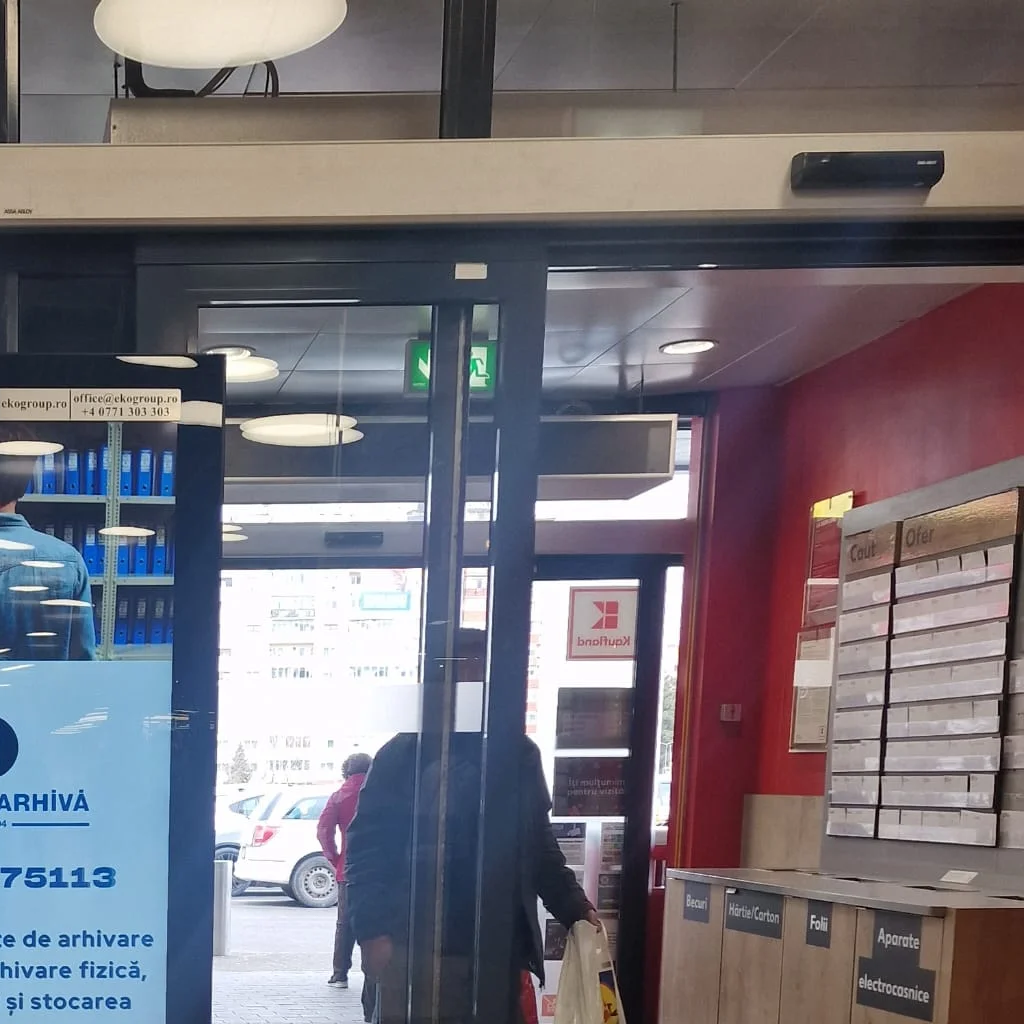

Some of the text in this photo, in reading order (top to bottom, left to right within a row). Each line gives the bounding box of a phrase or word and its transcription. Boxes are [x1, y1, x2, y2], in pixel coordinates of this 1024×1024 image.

[1, 399, 67, 411] ekogroup.ro
[73, 393, 178, 406] office@ekogroup.ro
[82, 407, 170, 417] +4 0771 303 303
[905, 527, 935, 548] Ofer
[686, 894, 708, 911] Becuri
[810, 914, 828, 932] Folii
[23, 930, 51, 948] de
[58, 930, 154, 948] arhivare
[877, 927, 920, 950] Aparate
[79, 961, 147, 982] fizică,
[858, 974, 930, 1004] electrocasnice
[6, 992, 24, 1016] și
[31, 993, 132, 1010] stocarea
